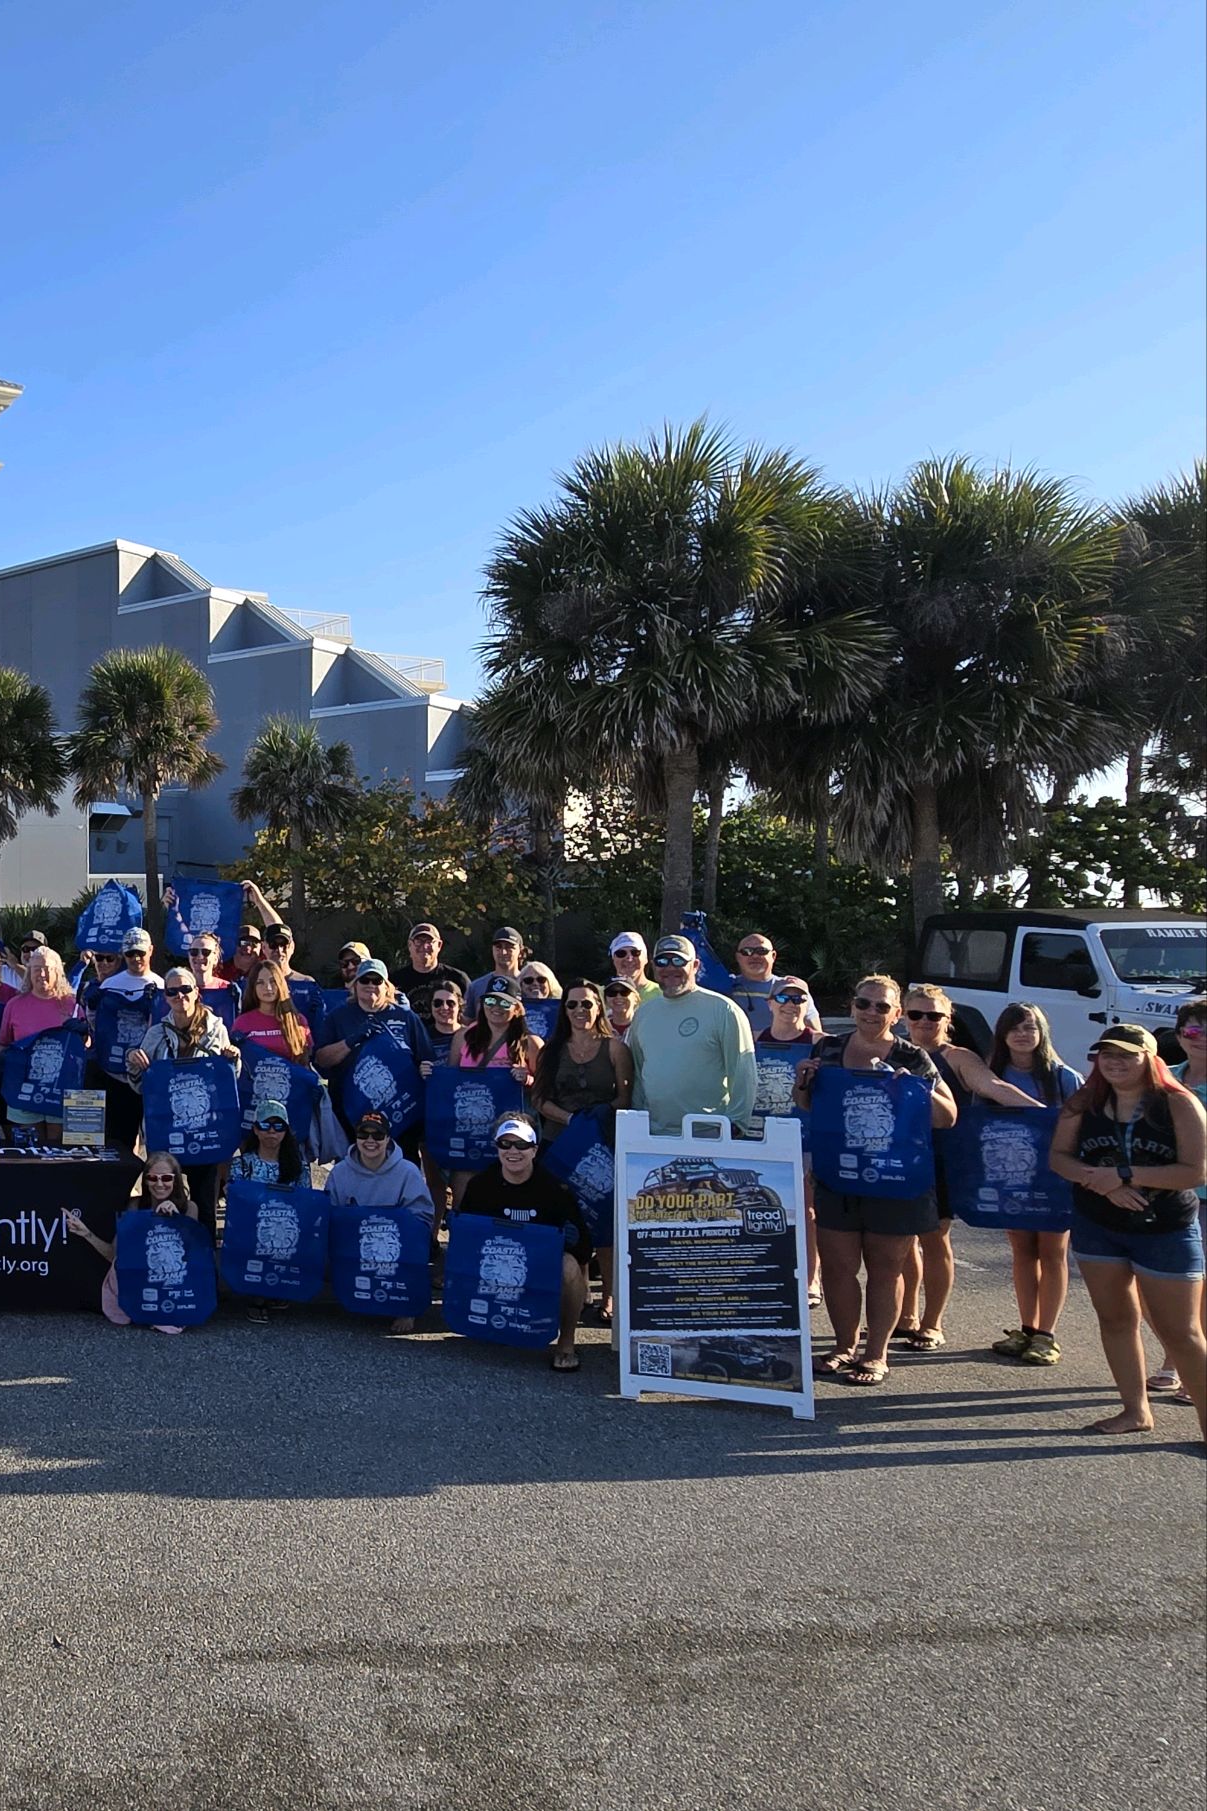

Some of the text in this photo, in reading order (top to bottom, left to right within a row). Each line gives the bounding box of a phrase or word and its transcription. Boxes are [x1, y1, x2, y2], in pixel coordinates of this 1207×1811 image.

[1146, 928, 1198, 938] RAMBLE
[255, 1066, 290, 1074] COASTAL
[168, 1077, 205, 1093] COASTAL
[454, 1088, 491, 1098] COASTAL
[842, 1094, 890, 1106] COASTAL
[636, 1192, 735, 1210] DO YOUR PART
[257, 1208, 297, 1218] COASTAL
[747, 1209, 781, 1221] tread
[359, 1223, 399, 1235] COASTAL
[748, 1220, 782, 1233] lightly!
[146, 1232, 182, 1245] COASTAL
[637, 1230, 669, 1239] OFF-ROAD
[702, 1228, 740, 1238] PRINCIPLES
[481, 1246, 527, 1256] COASTAL
[360, 1262, 399, 1272] CLEANUP
[148, 1270, 188, 1283] CLEANUP
[478, 1285, 525, 1295] CLEANUP
